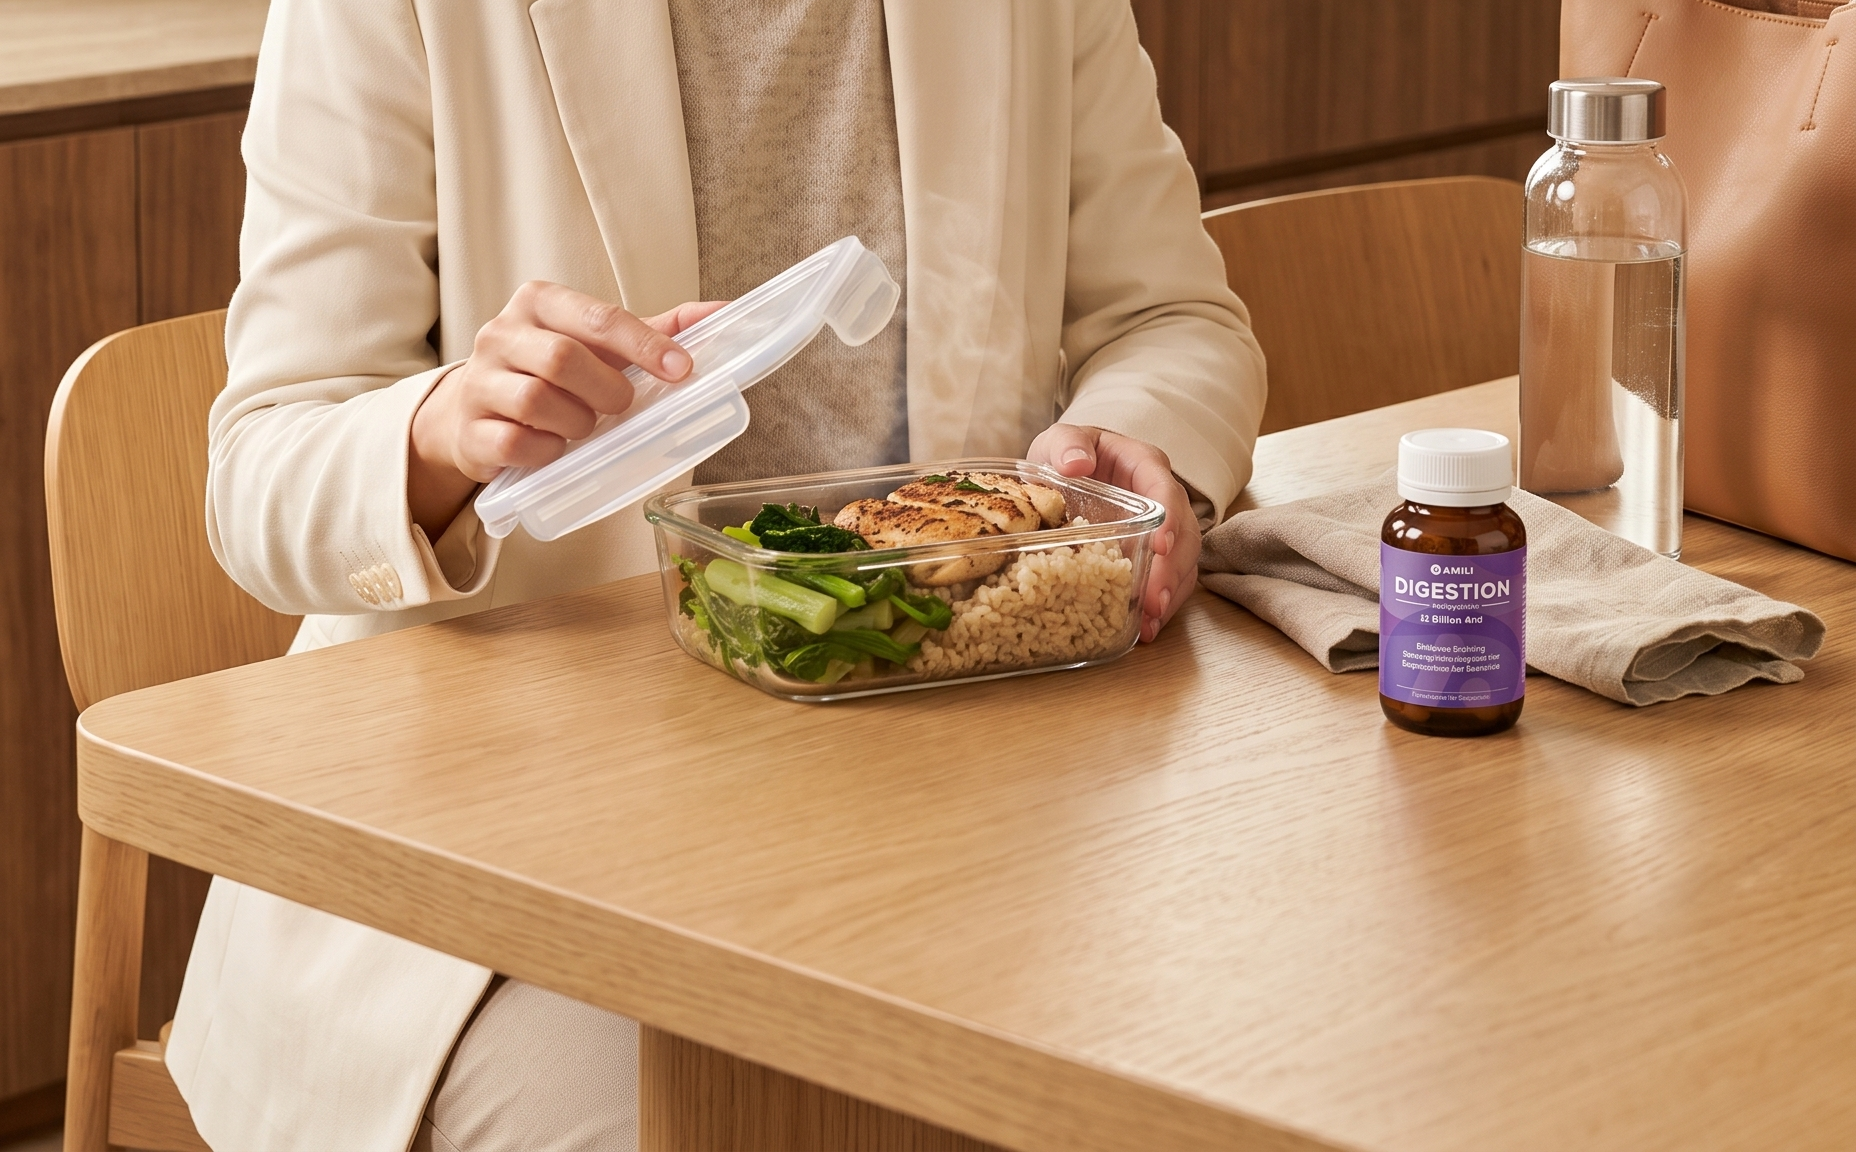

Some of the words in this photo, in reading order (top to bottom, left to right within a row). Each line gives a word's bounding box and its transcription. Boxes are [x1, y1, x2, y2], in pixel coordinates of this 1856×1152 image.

[1443, 567, 1474, 575] AMILI
[1395, 576, 1510, 600] DIGESTION
[1465, 616, 1483, 624] And
